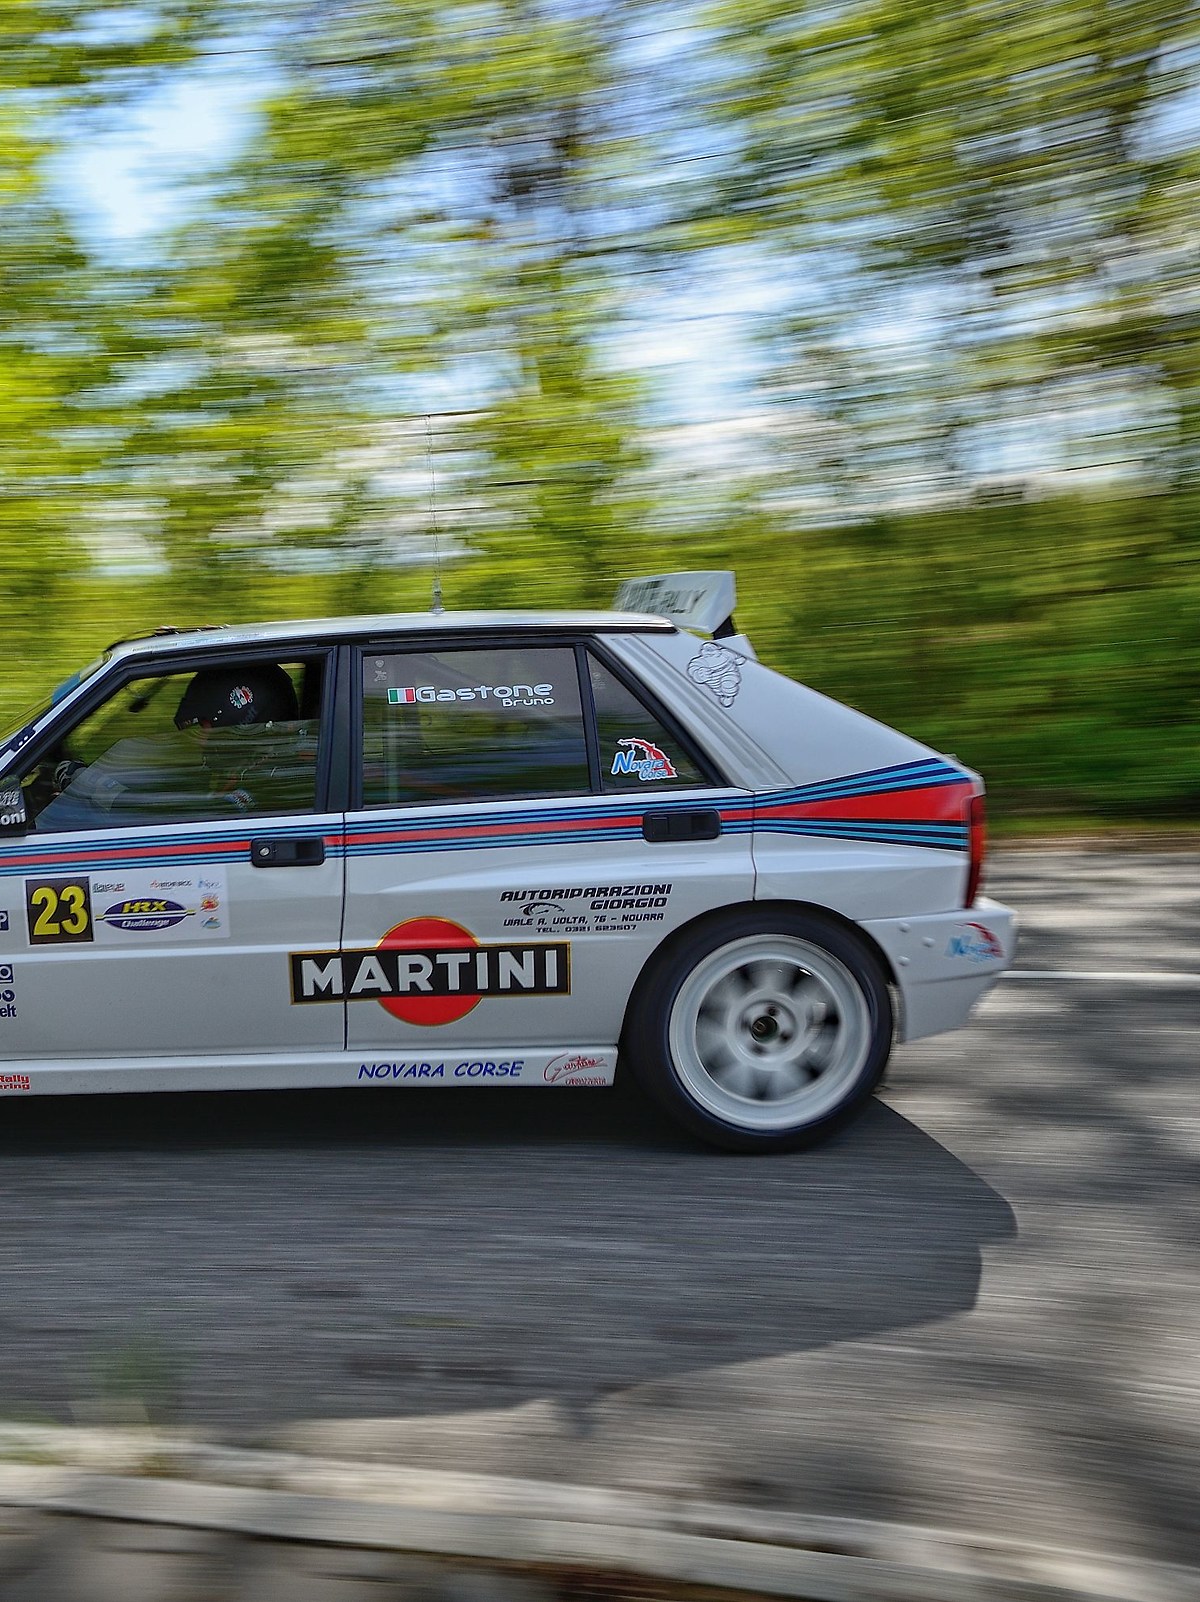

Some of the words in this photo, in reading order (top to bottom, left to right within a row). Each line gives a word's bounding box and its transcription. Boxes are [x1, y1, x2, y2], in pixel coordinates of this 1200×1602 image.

[415, 684, 553, 703] Gastone
[501, 697, 555, 707] Bruno
[611, 750, 665, 775] Novara
[640, 768, 668, 780] Corse
[500, 884, 672, 901] AUTORIPARAZIONI
[31, 885, 90, 936] 23
[122, 900, 168, 913] HRX
[589, 897, 667, 910] GIORGIO
[300, 949, 559, 997] MARTINI
[357, 1063, 445, 1080] NOVARA
[454, 1061, 525, 1078] CORSE
